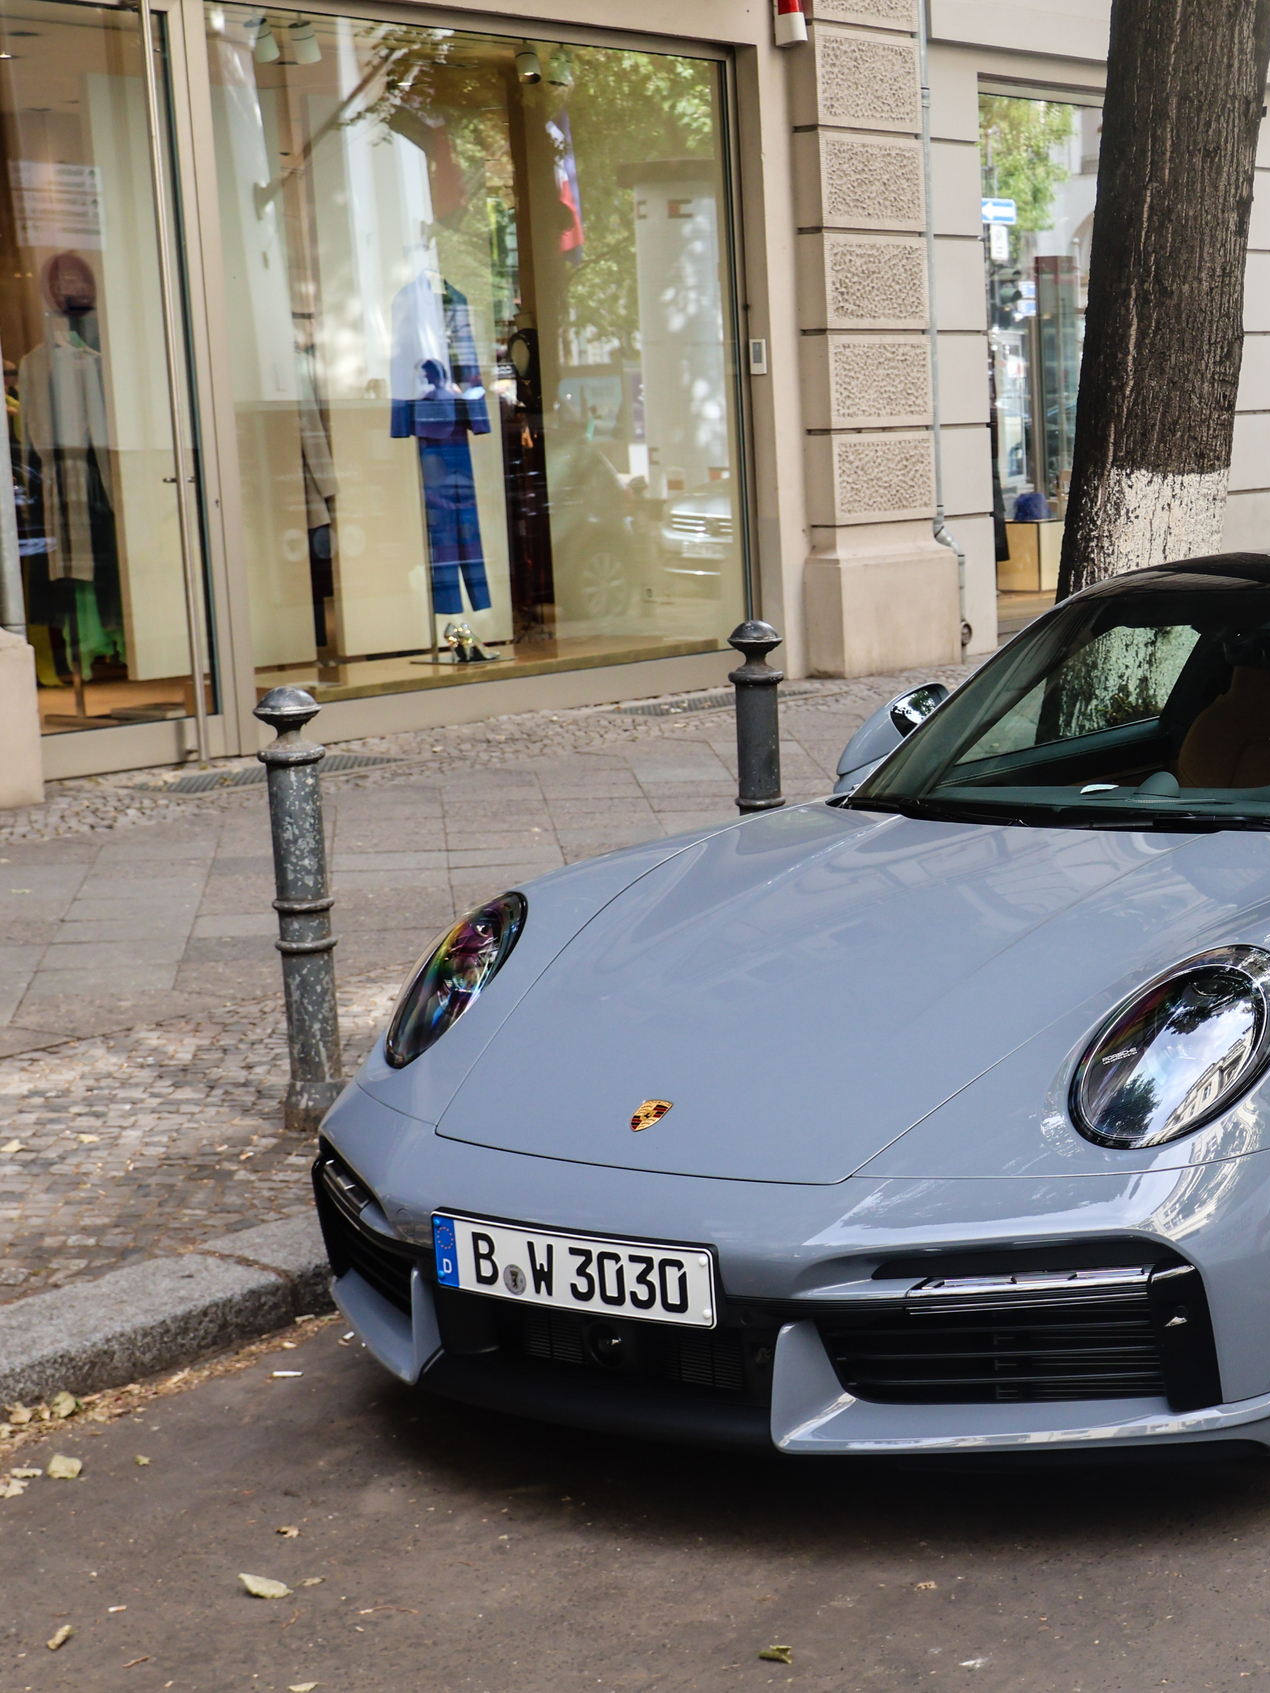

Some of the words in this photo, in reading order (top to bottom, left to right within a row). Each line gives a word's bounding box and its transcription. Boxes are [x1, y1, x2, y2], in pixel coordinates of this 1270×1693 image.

[443, 1258, 452, 1273] D
[471, 1231, 499, 1285] B
[527, 1240, 554, 1296] W
[568, 1246, 689, 1313] 3030
